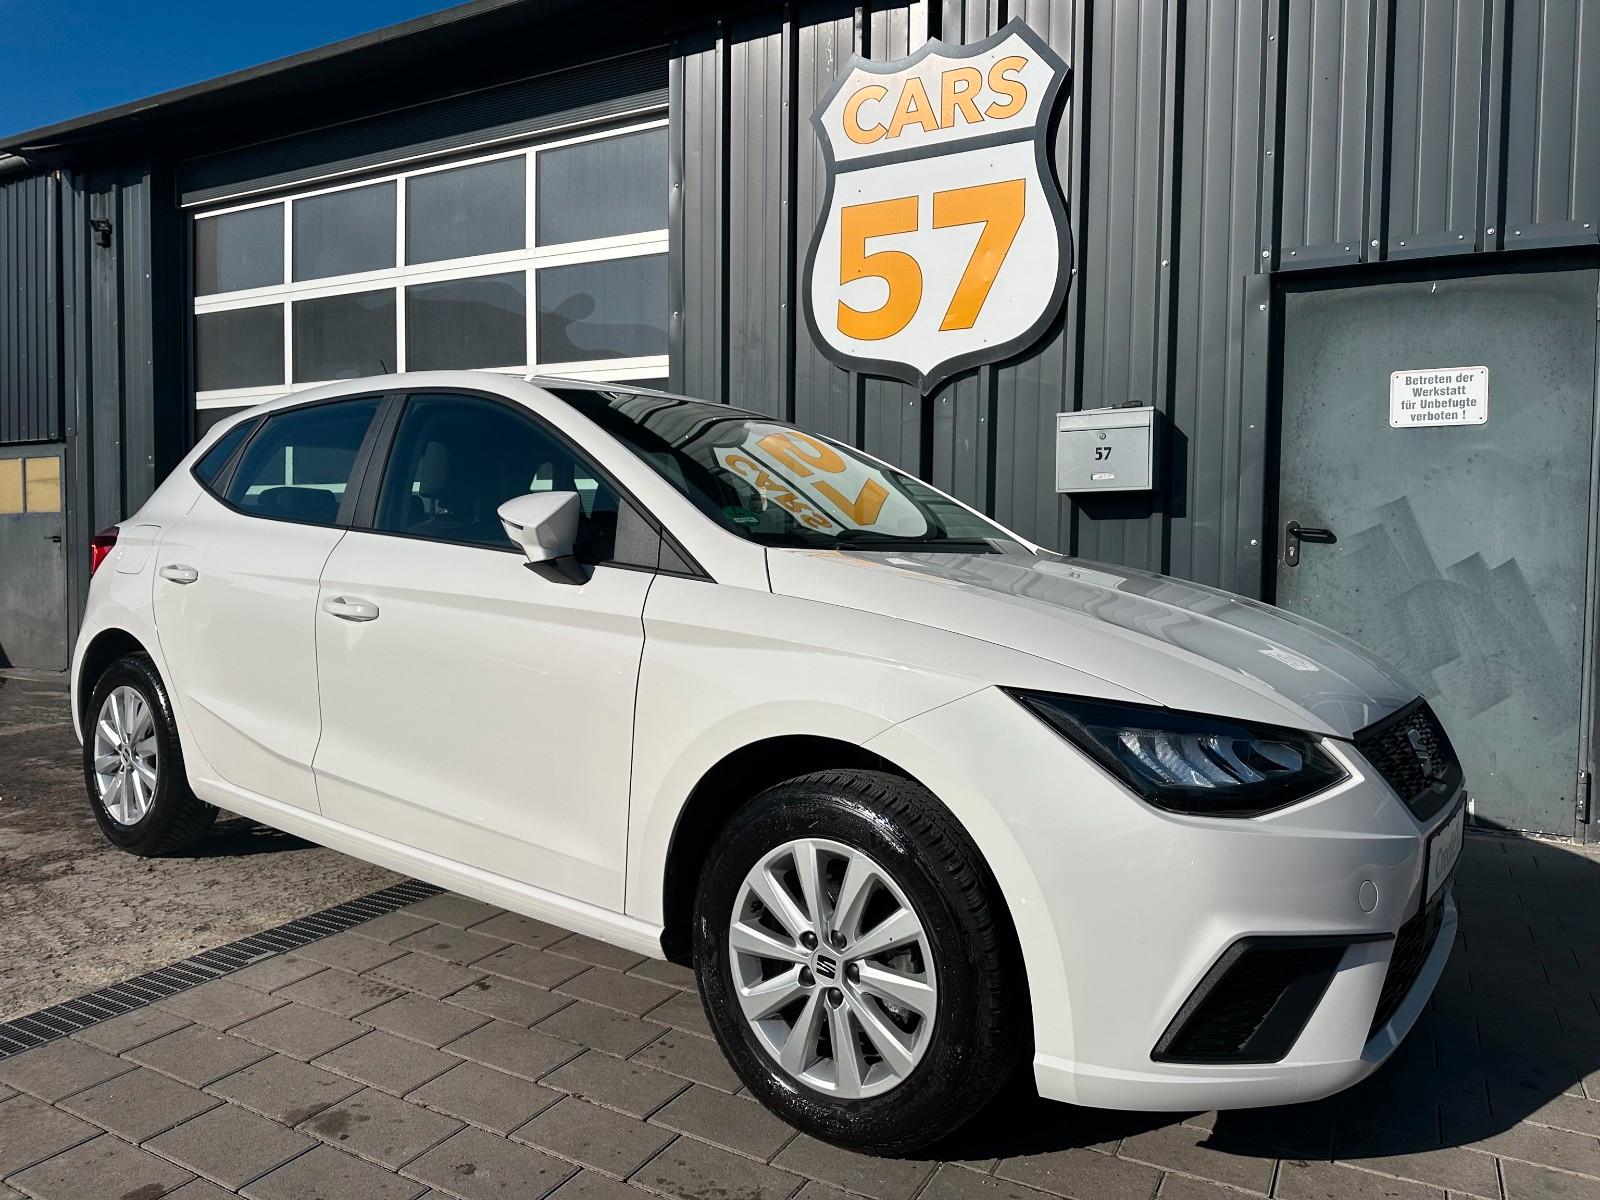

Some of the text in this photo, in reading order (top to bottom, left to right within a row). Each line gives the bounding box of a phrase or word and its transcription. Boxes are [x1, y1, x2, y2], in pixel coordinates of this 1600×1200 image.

[842, 55, 1029, 145] CARS
[837, 178, 1027, 341] 57
[1405, 373, 1474, 386] Betreten der
[1412, 385, 1466, 397] Werkstatt
[1400, 397, 1477, 410] für Unbefugte
[1410, 409, 1466, 421] verboten !
[1094, 446, 1112, 461] 57
